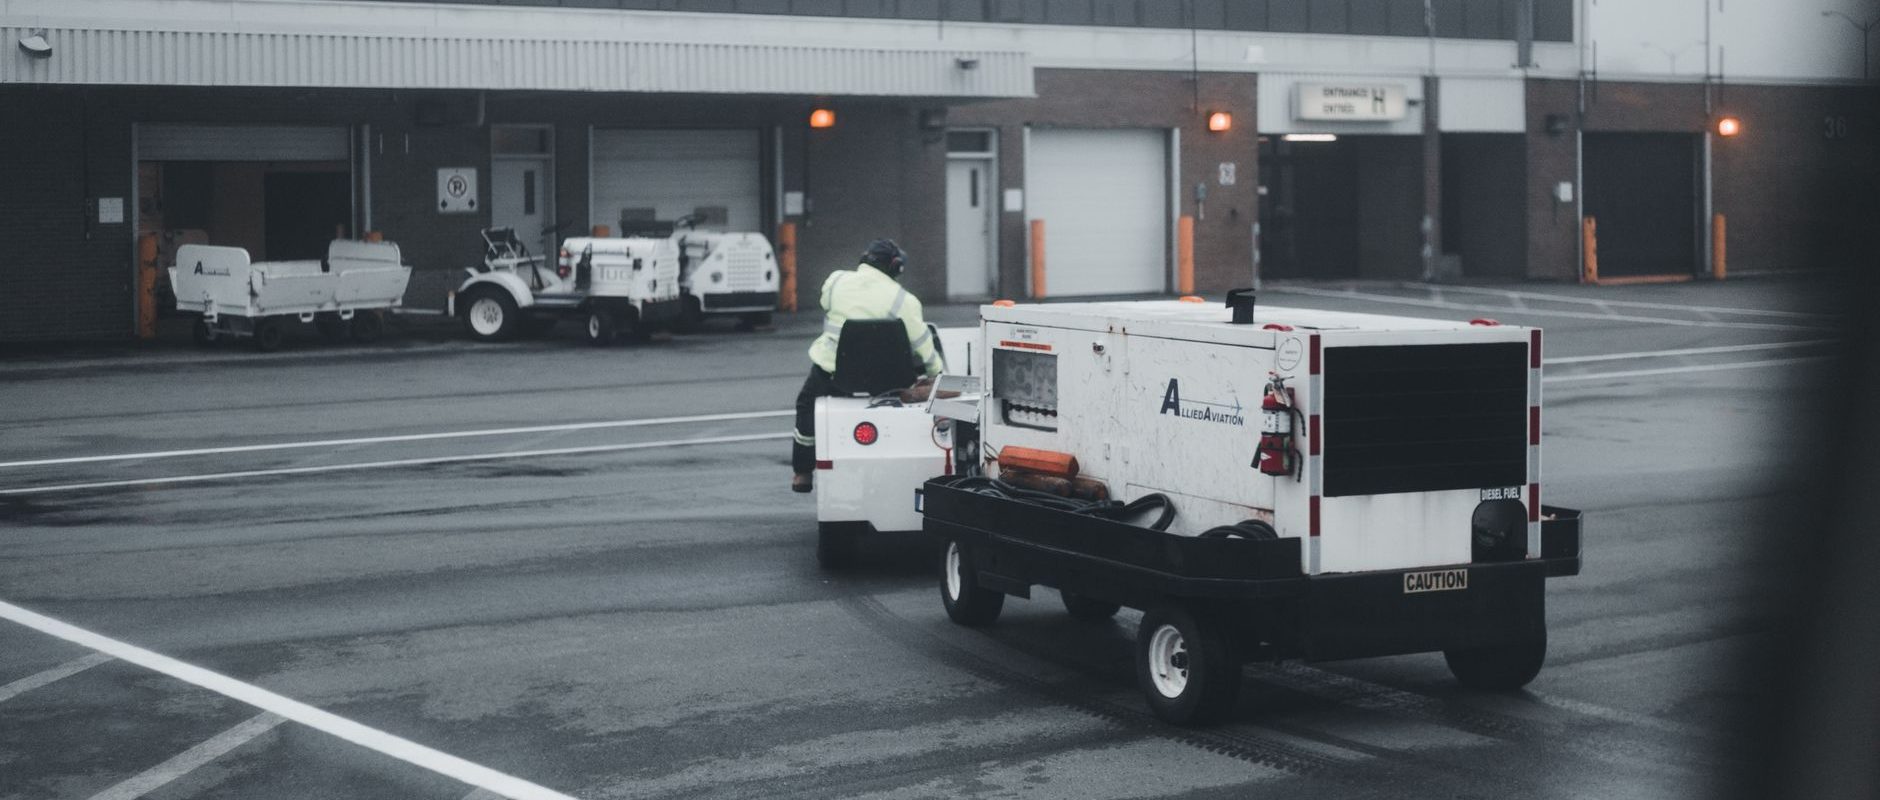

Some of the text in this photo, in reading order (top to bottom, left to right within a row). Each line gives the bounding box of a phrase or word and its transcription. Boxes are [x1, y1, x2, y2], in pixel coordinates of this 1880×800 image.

[1824, 116, 1847, 139] 36
[1481, 487, 1520, 500] DIESEL FUEL
[1406, 570, 1466, 591] CAUTION
